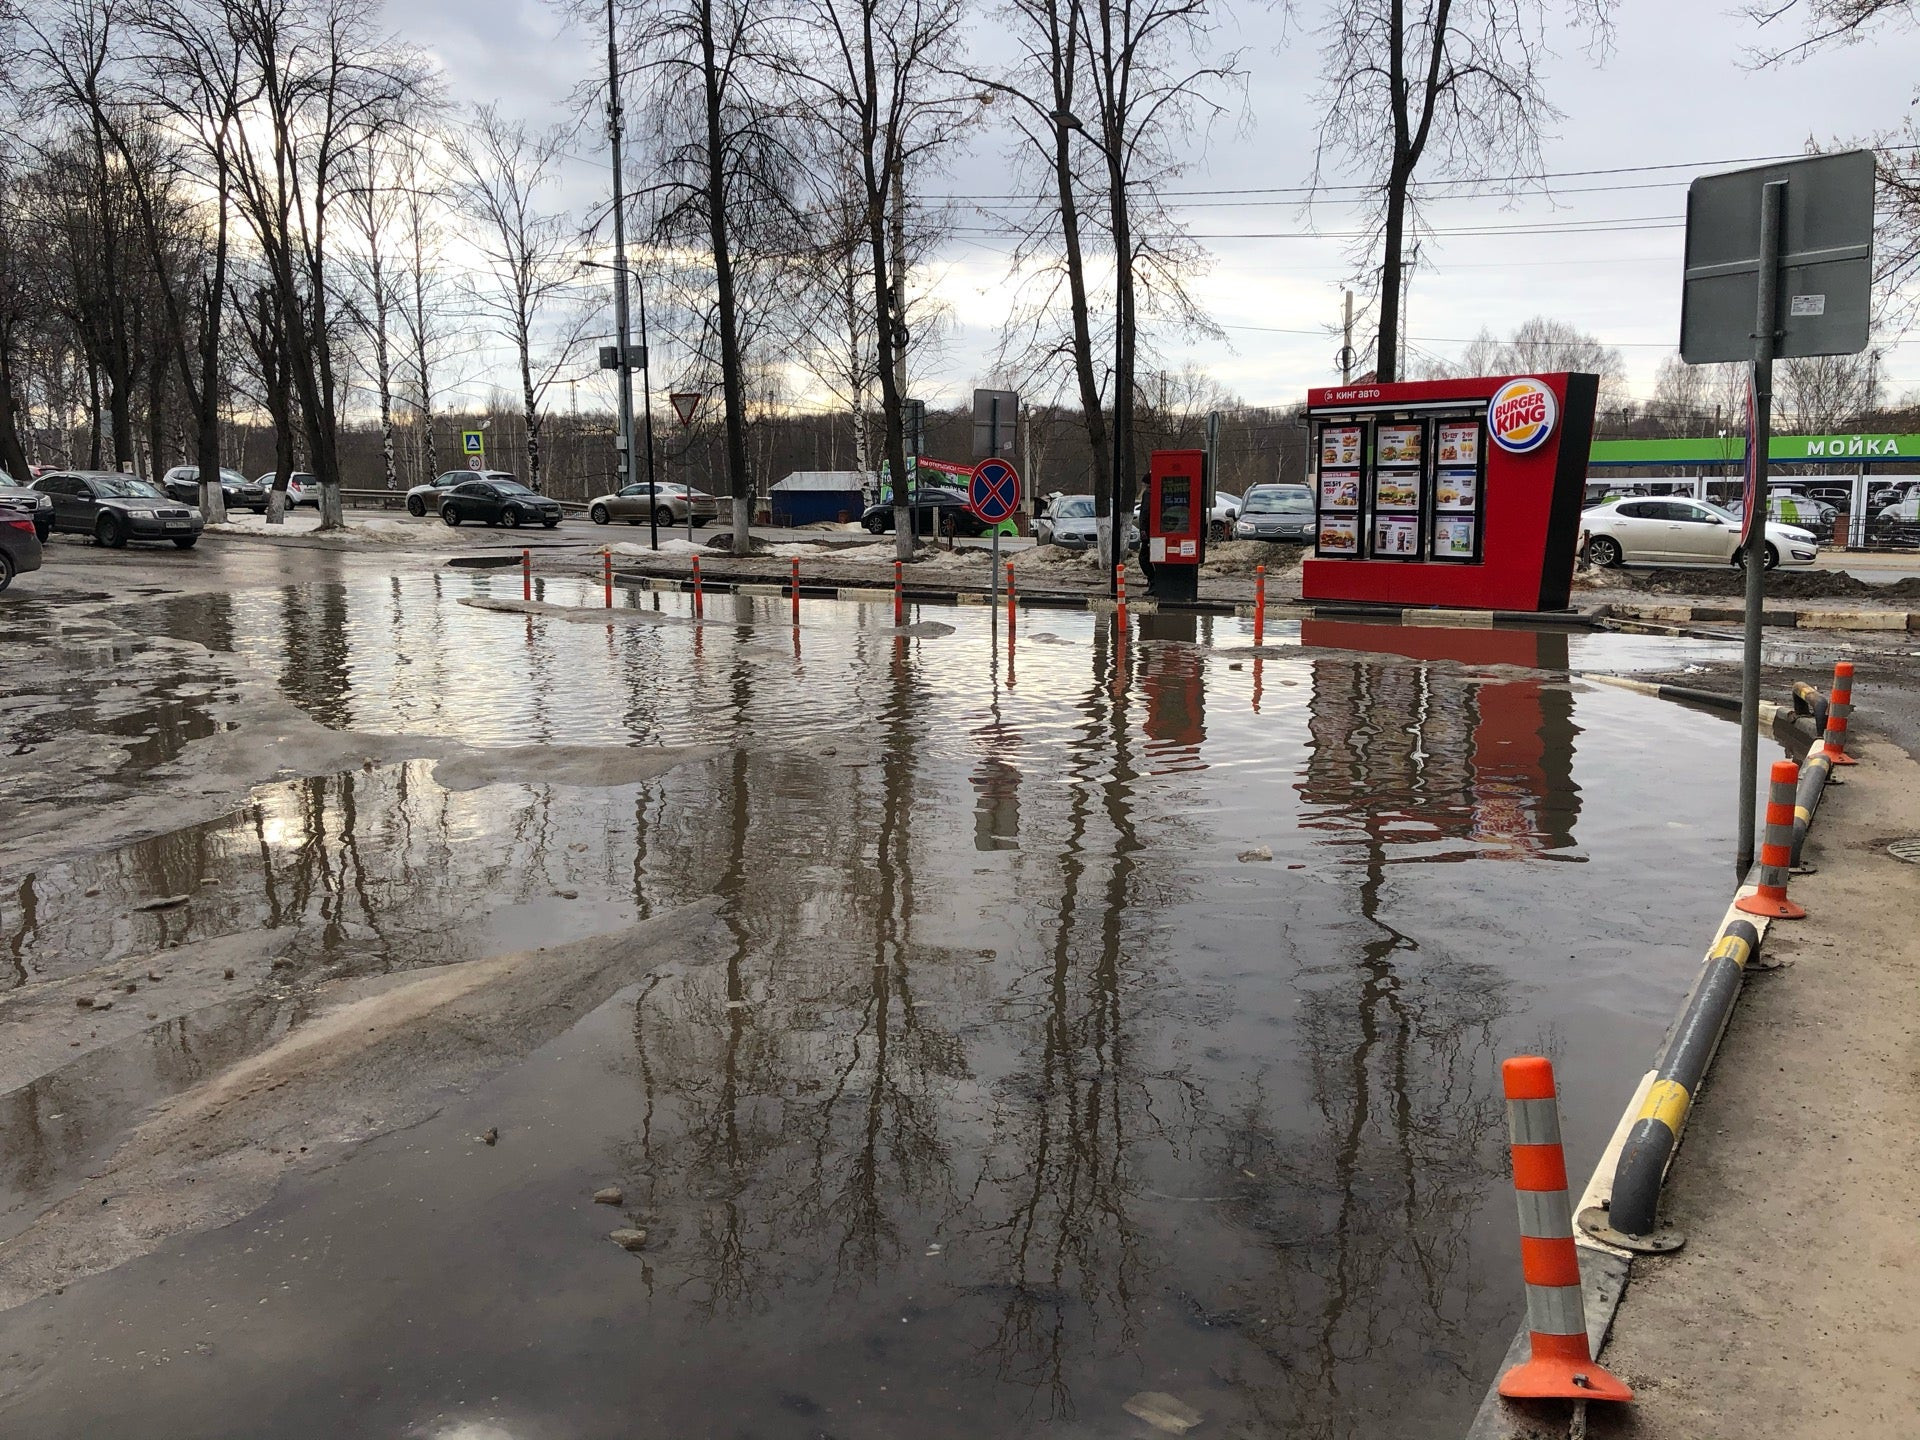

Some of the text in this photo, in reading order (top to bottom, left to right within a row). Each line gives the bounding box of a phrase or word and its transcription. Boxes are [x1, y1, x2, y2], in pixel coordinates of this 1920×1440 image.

[1495, 392, 1545, 419] BURGER
[1496, 405, 1546, 436] KING
[1807, 435, 1899, 456] МОЙКА
